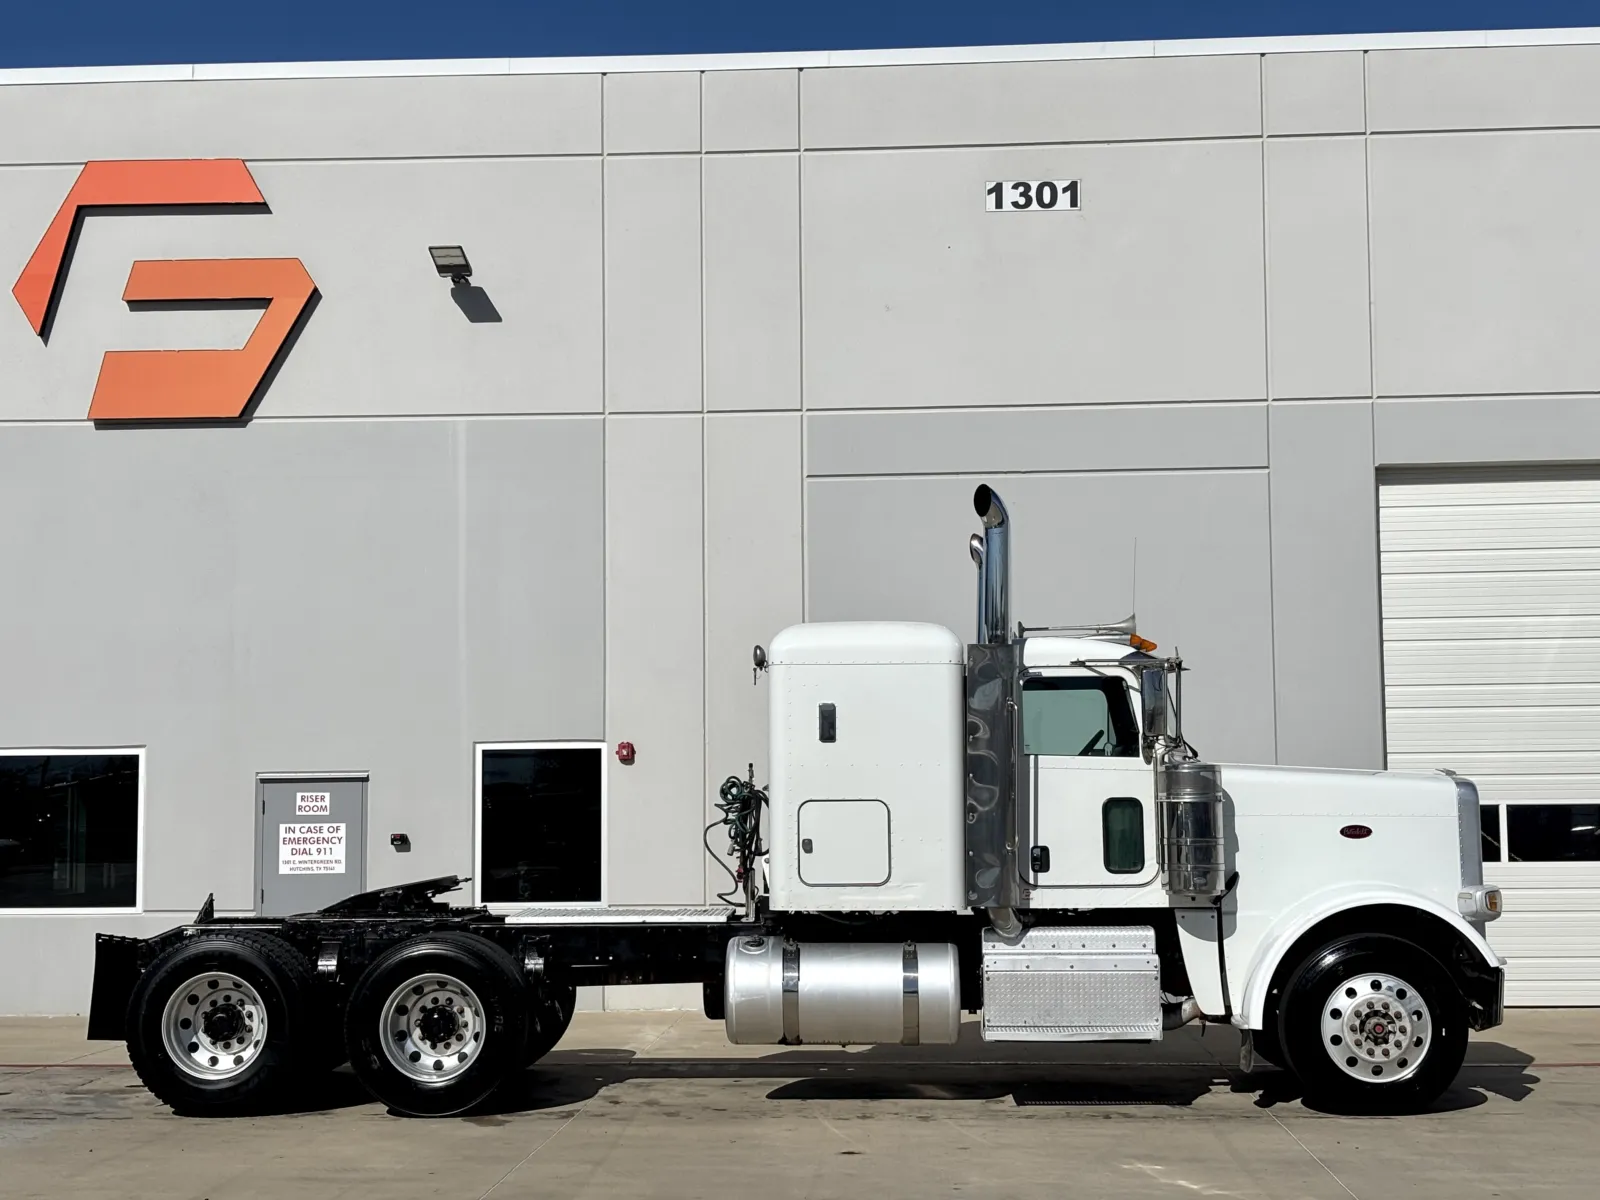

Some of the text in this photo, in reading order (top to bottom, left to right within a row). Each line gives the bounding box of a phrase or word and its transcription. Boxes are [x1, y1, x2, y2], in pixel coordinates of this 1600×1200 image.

[987, 181, 1078, 209] 1301
[300, 794, 326, 803] RISER
[298, 805, 328, 813] ROOM
[284, 825, 341, 834] IN CASE OF
[282, 836, 343, 845] EMERGENCY
[291, 847, 333, 856] DIAL 911
